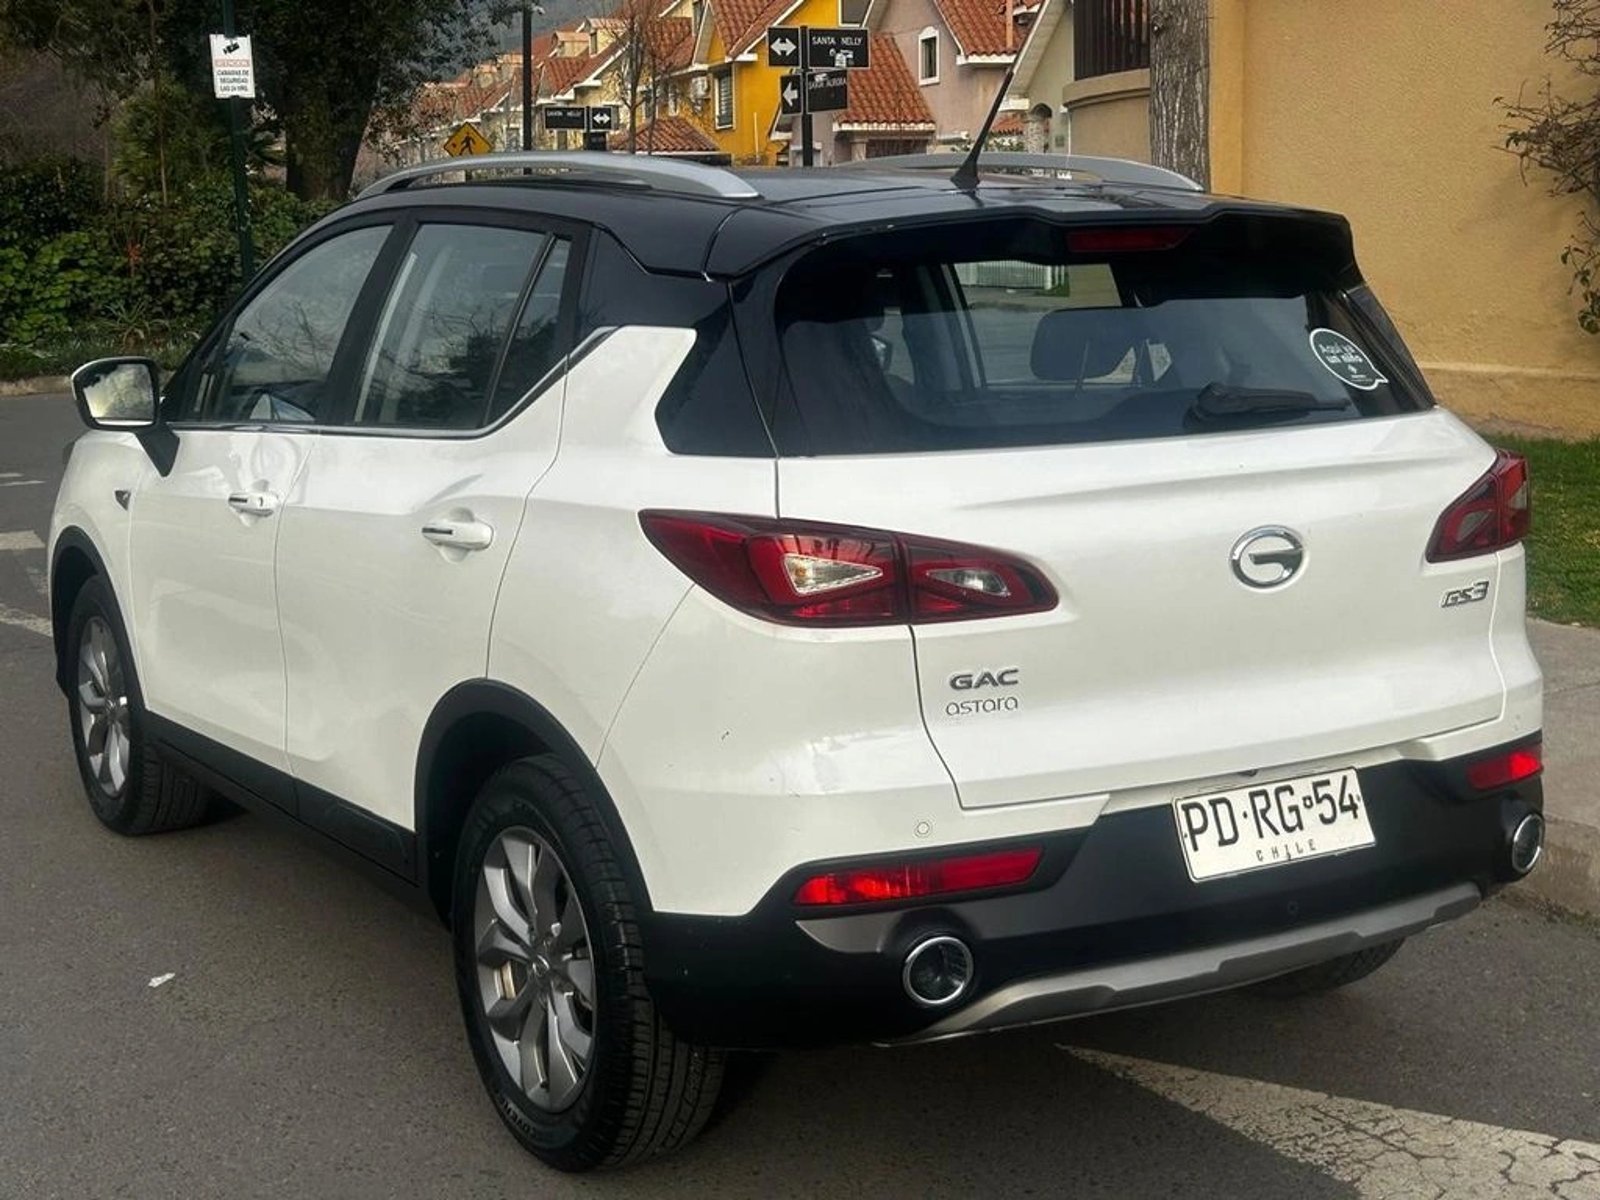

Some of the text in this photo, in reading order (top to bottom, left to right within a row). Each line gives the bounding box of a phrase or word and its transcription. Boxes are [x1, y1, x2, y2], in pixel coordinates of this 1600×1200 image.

[812, 36, 862, 46] SANTA NELLY
[1441, 580, 1490, 608] GS3
[950, 668, 1019, 691] GAC
[945, 696, 1018, 716] astara
[1255, 837, 1317, 862] CHILE
